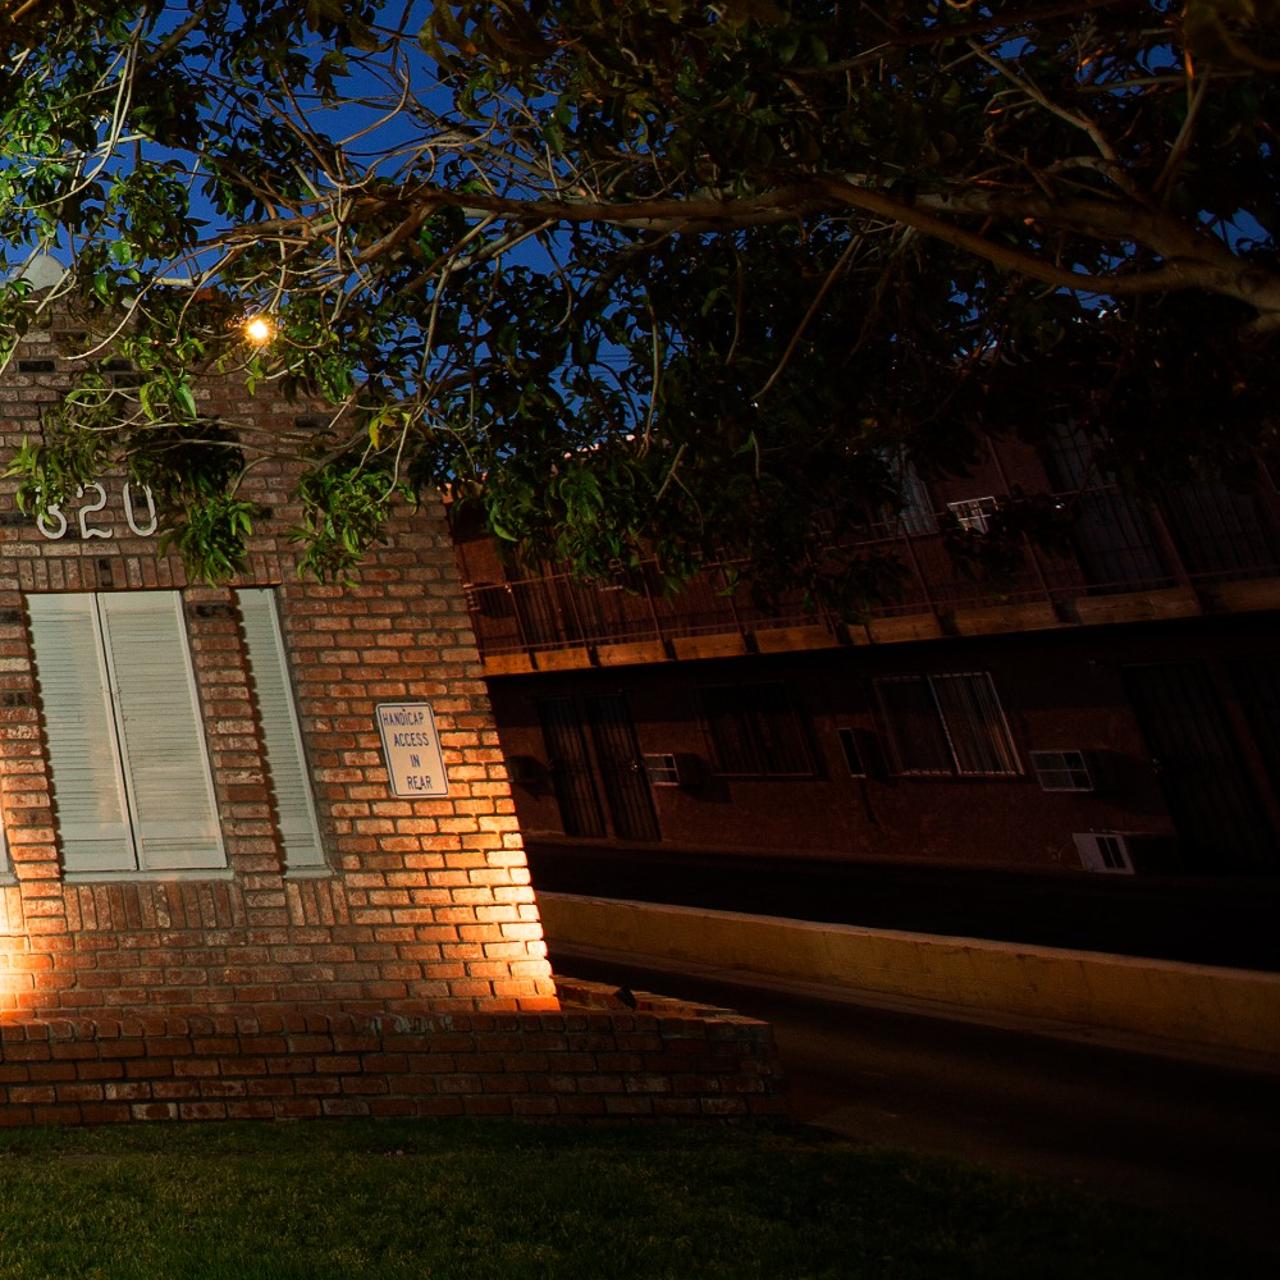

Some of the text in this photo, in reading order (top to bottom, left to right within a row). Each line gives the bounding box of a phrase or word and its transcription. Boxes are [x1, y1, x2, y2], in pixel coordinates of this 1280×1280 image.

[382, 712, 424, 726] HANDICAP
[393, 732, 430, 747] ACCESS
[410, 754, 421, 768] IN
[406, 775, 433, 791] REAR
